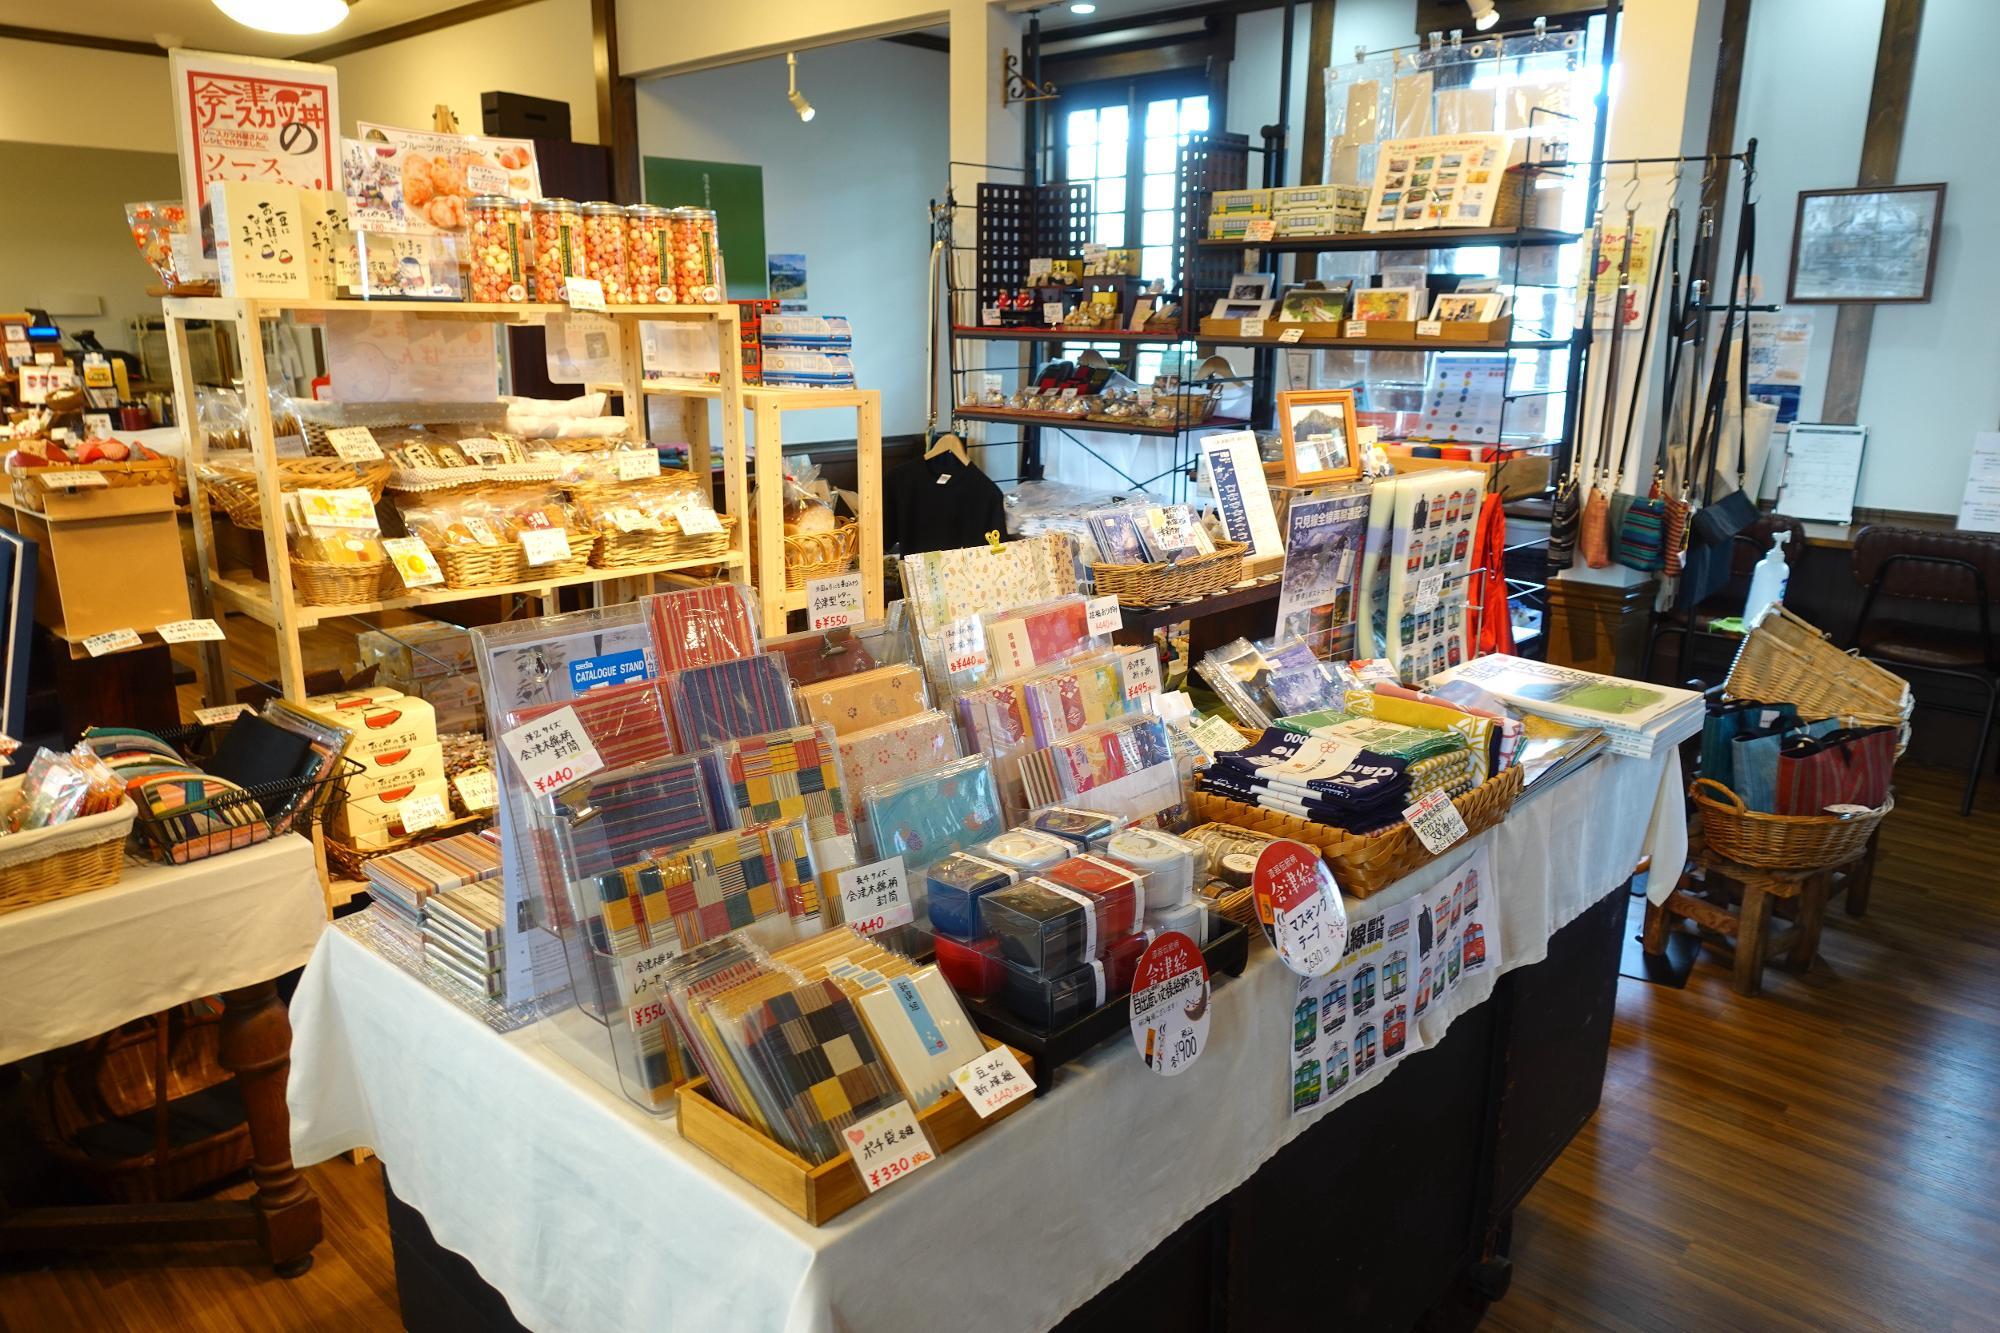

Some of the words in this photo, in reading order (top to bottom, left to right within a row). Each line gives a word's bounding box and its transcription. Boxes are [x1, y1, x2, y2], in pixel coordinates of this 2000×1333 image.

[194, 80, 269, 107] 会津
[198, 103, 323, 129] ソースカツ丼
[280, 122, 318, 156] の
[206, 153, 281, 176] ソース
[575, 666, 617, 683] CATALOGUE
[619, 660, 645, 674] STAND
[534, 767, 573, 793] ¥440
[1271, 863, 1314, 904] 会津絵
[1289, 896, 1327, 932] マスキング
[1146, 948, 1188, 987] 会津絵
[868, 1157, 909, 1188] ¥330
